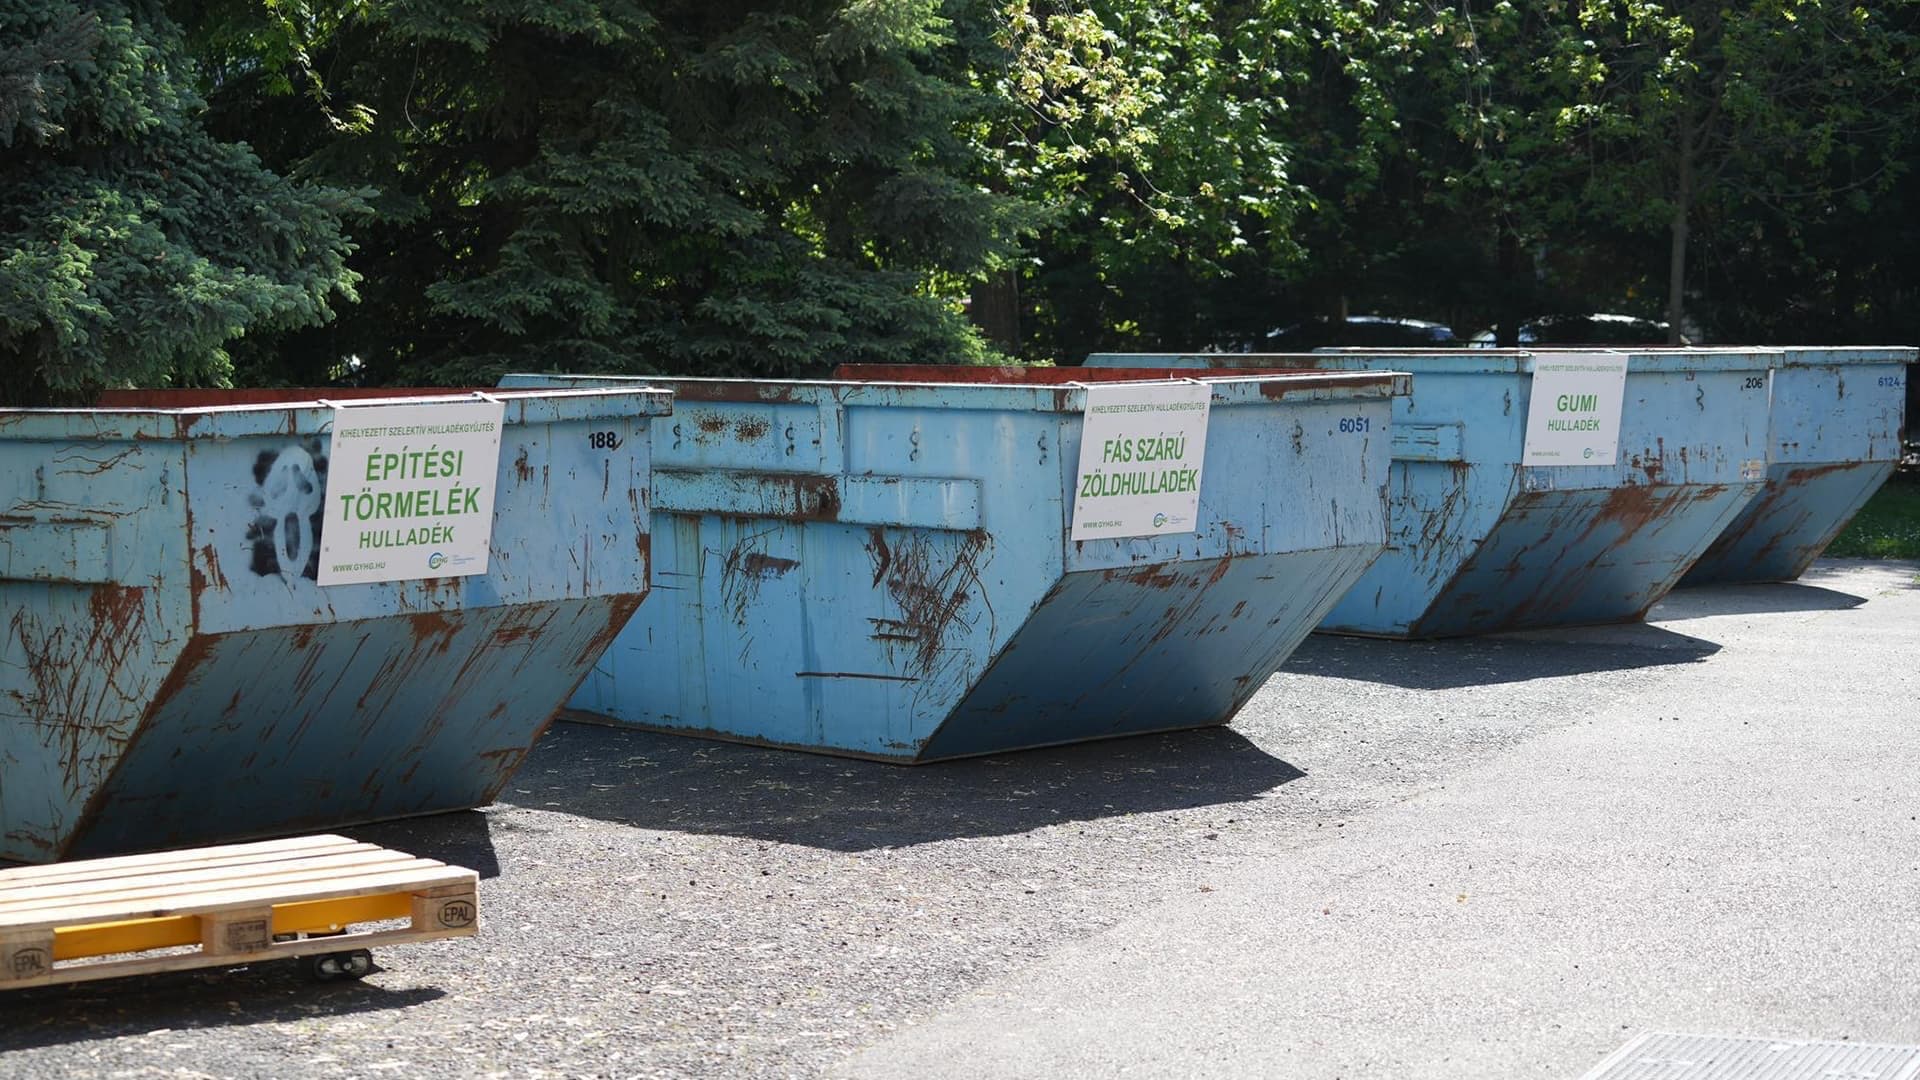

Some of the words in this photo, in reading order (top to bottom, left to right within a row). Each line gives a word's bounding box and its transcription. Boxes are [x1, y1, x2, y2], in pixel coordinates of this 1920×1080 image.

[1745, 377, 1763, 389] 206
[1878, 377, 1900, 387] 6124
[1557, 394, 1598, 412] GUMI
[340, 427, 387, 438] KIHELYEZETT
[388, 425, 426, 436] SZELEKTÍV
[1340, 417, 1369, 433] 6051
[1548, 416, 1600, 431] HULLADÉK
[588, 431, 616, 449] 188
[1103, 433, 1133, 463] FÁS
[1136, 431, 1185, 461] SZÁRÚ
[366, 444, 463, 481] ÉPÍTÉSI
[1080, 463, 1198, 498] ZÖLDHULLADÉK
[340, 482, 481, 522] TÖRMELÉK
[359, 522, 455, 549] HULLADÉK
[332, 561, 386, 573] WWW.GYHG.HU
[444, 906, 471, 922] EPAL
[14, 953, 45, 973] EPAL
